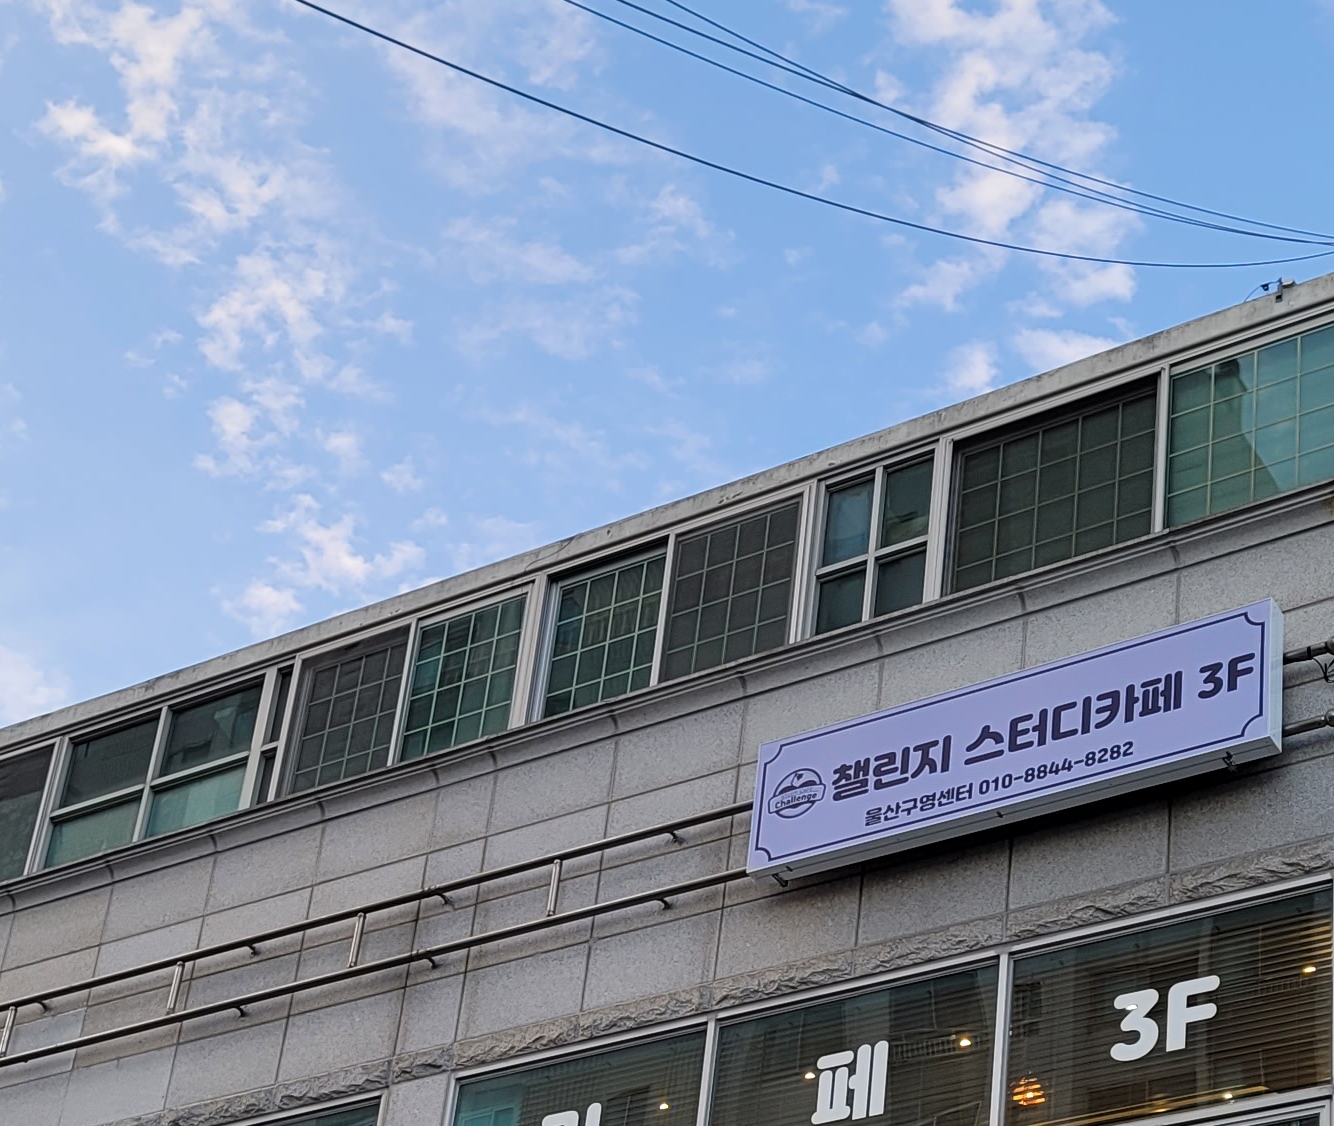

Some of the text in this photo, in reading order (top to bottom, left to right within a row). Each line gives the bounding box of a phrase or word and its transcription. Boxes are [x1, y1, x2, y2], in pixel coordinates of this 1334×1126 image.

[831, 652, 1256, 802] 챌린지 스터디카페 3F
[774, 791, 818, 810] Challenge
[863, 741, 1135, 828] 울산구영센터 010-8844-8282
[1110, 974, 1221, 1062] 3F
